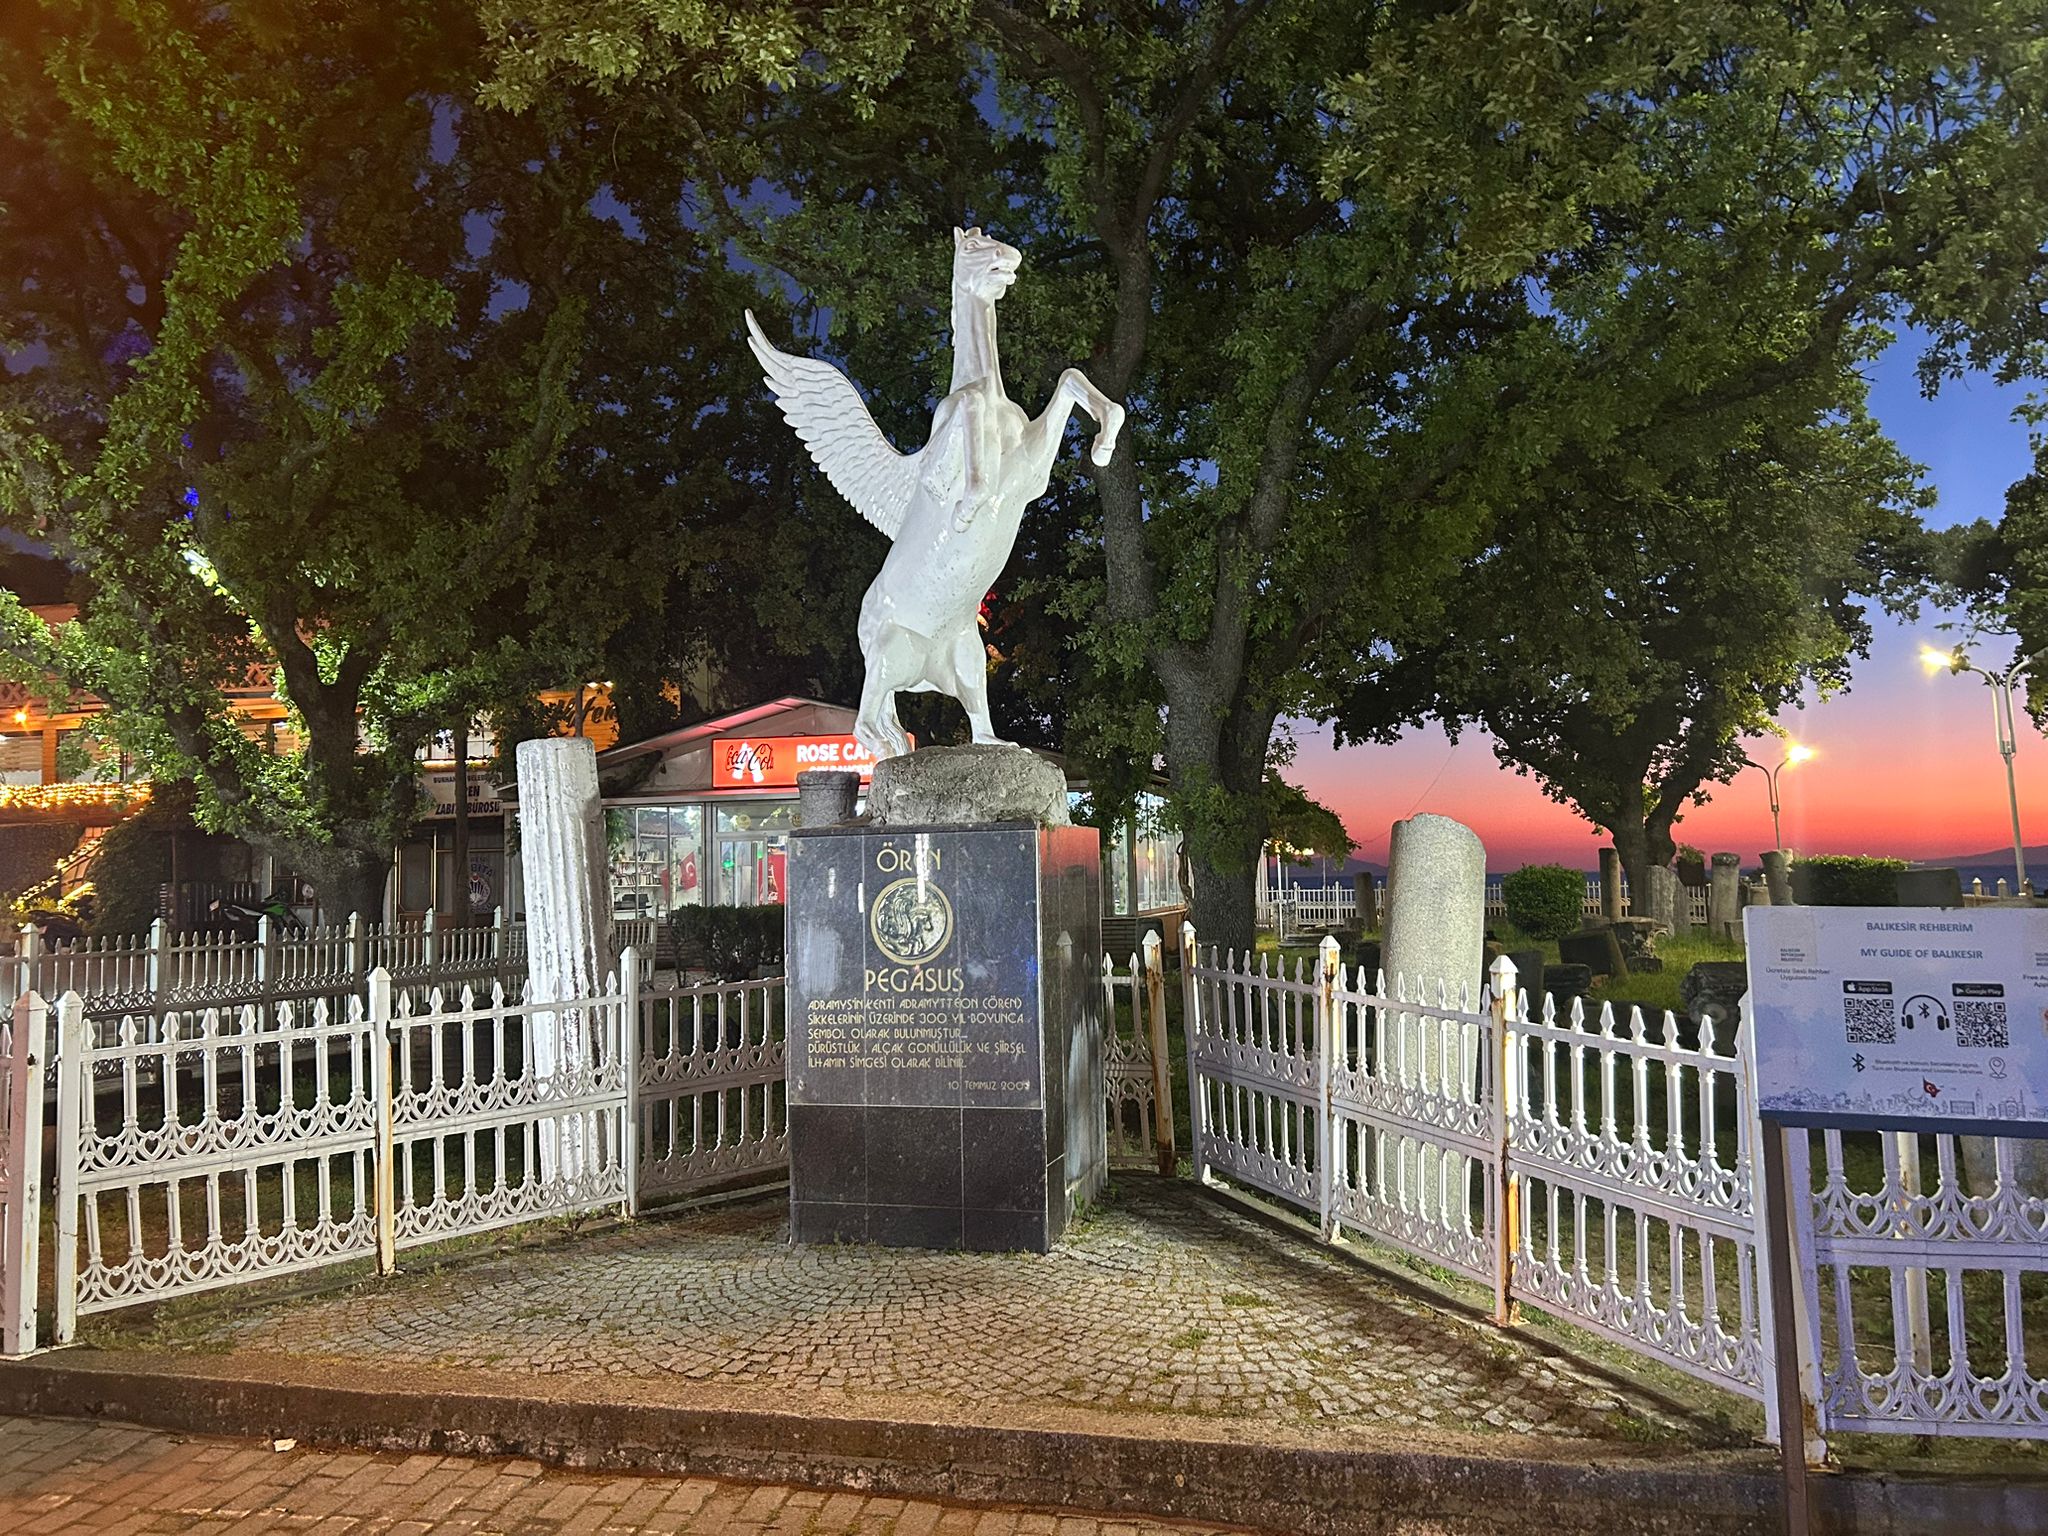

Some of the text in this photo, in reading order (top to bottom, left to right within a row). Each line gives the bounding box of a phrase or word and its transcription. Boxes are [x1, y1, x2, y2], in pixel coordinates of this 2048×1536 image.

[796, 743, 840, 763] ROSE
[1866, 920, 1973, 933] BALIKESİR REHBERİM
[1860, 948, 1878, 957] MY
[1880, 948, 1912, 958] GUIDE
[1915, 949, 1929, 958] OF
[865, 967, 965, 993] PEGASUS
[865, 996, 895, 1009] KENTİ
[899, 997, 979, 1009] ADRAMYTTEON
[982, 995, 1023, 1010] (ÖREN)
[868, 1011, 915, 1025] ÜZERİNDE
[919, 1012, 948, 1024] 300
[951, 1012, 967, 1024] YIL
[970, 1012, 1024, 1024] BOYUNCA
[807, 1028, 847, 1040] SEMBOL
[850, 1027, 890, 1040] OLARAK
[871, 1042, 904, 1056] ALÇAK
[976, 1042, 990, 1053] VE
[849, 1055, 887, 1069] SİMGESİ
[890, 1057, 931, 1069] OLARAK
[964, 1080, 997, 1091] TEMMUZ
